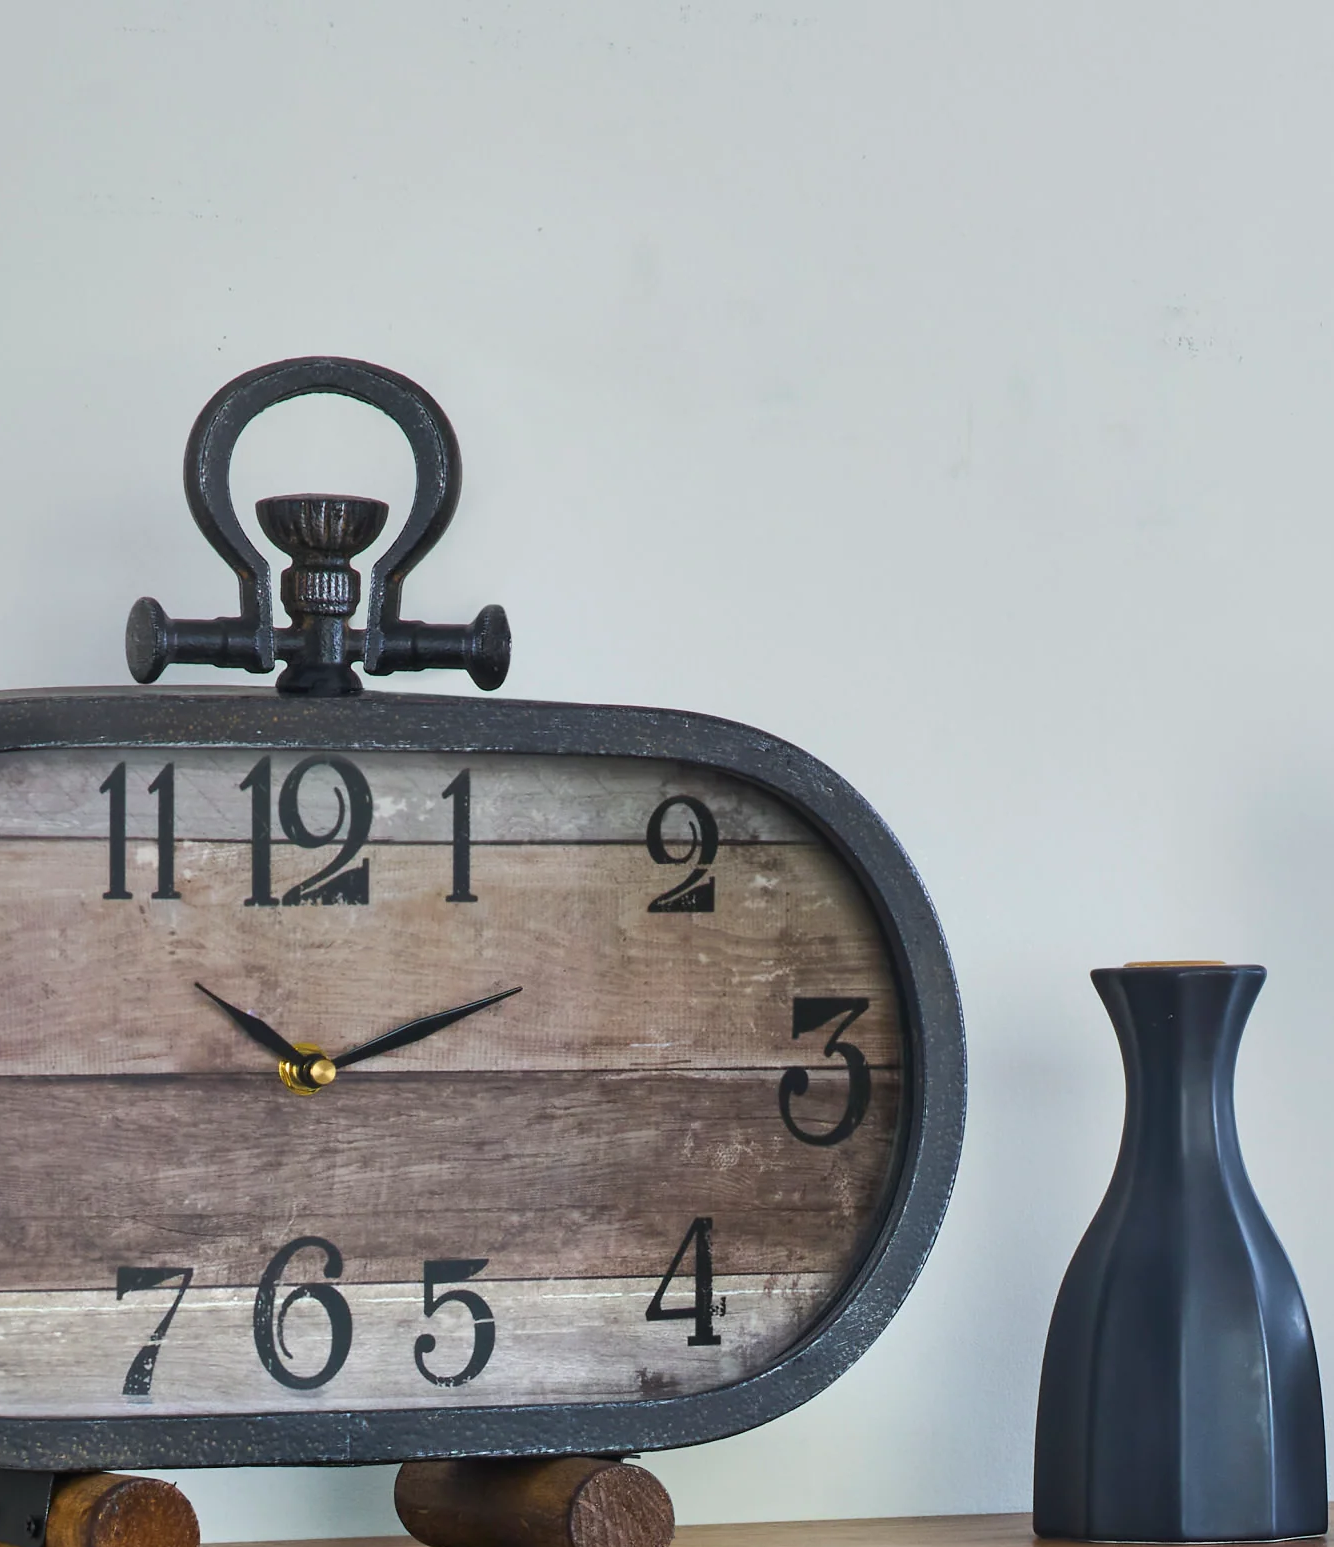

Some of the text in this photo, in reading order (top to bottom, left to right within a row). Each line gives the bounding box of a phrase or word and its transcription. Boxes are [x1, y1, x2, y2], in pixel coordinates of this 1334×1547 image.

[100, 761, 181, 900] 11
[239, 753, 374, 907] 12
[441, 767, 478, 903] 1
[645, 795, 720, 913] 2
[779, 997, 872, 1147] 3
[116, 1266, 195, 1395] 7
[253, 1235, 353, 1390] 6
[414, 1258, 497, 1388] 5
[645, 1217, 728, 1347] 4
